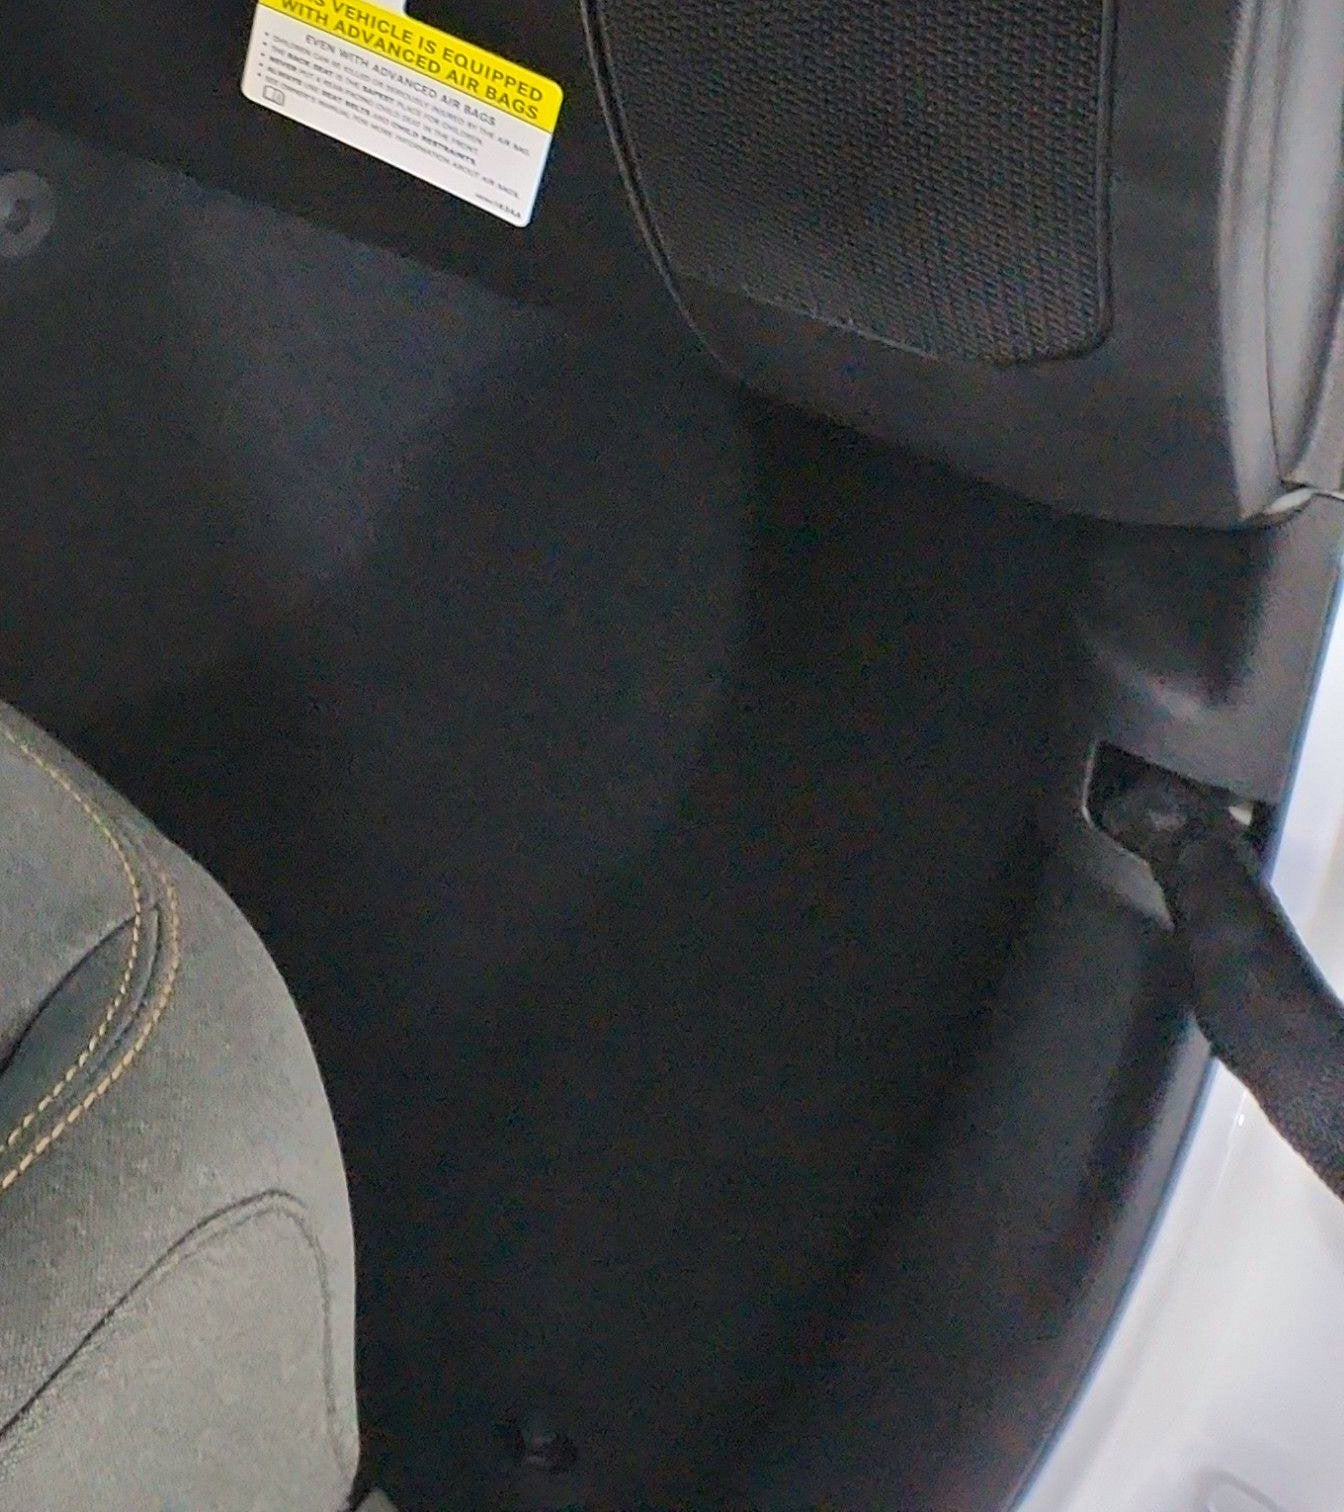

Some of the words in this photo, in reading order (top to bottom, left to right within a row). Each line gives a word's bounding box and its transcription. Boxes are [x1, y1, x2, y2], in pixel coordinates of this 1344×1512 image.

[305, 34, 335, 54] EVEN
[338, 49, 367, 68] WITH
[372, 64, 437, 99] ADVANCED
[440, 94, 460, 110] AIR
[463, 105, 495, 126] BAGS
[331, 0, 412, 45] VEHICLE
[418, 38, 436, 55] IS
[443, 49, 543, 102] EQUIPPED
[334, 20, 440, 75] ADVANCED
[446, 69, 478, 92] AIR
[485, 86, 538, 118] BAGS
